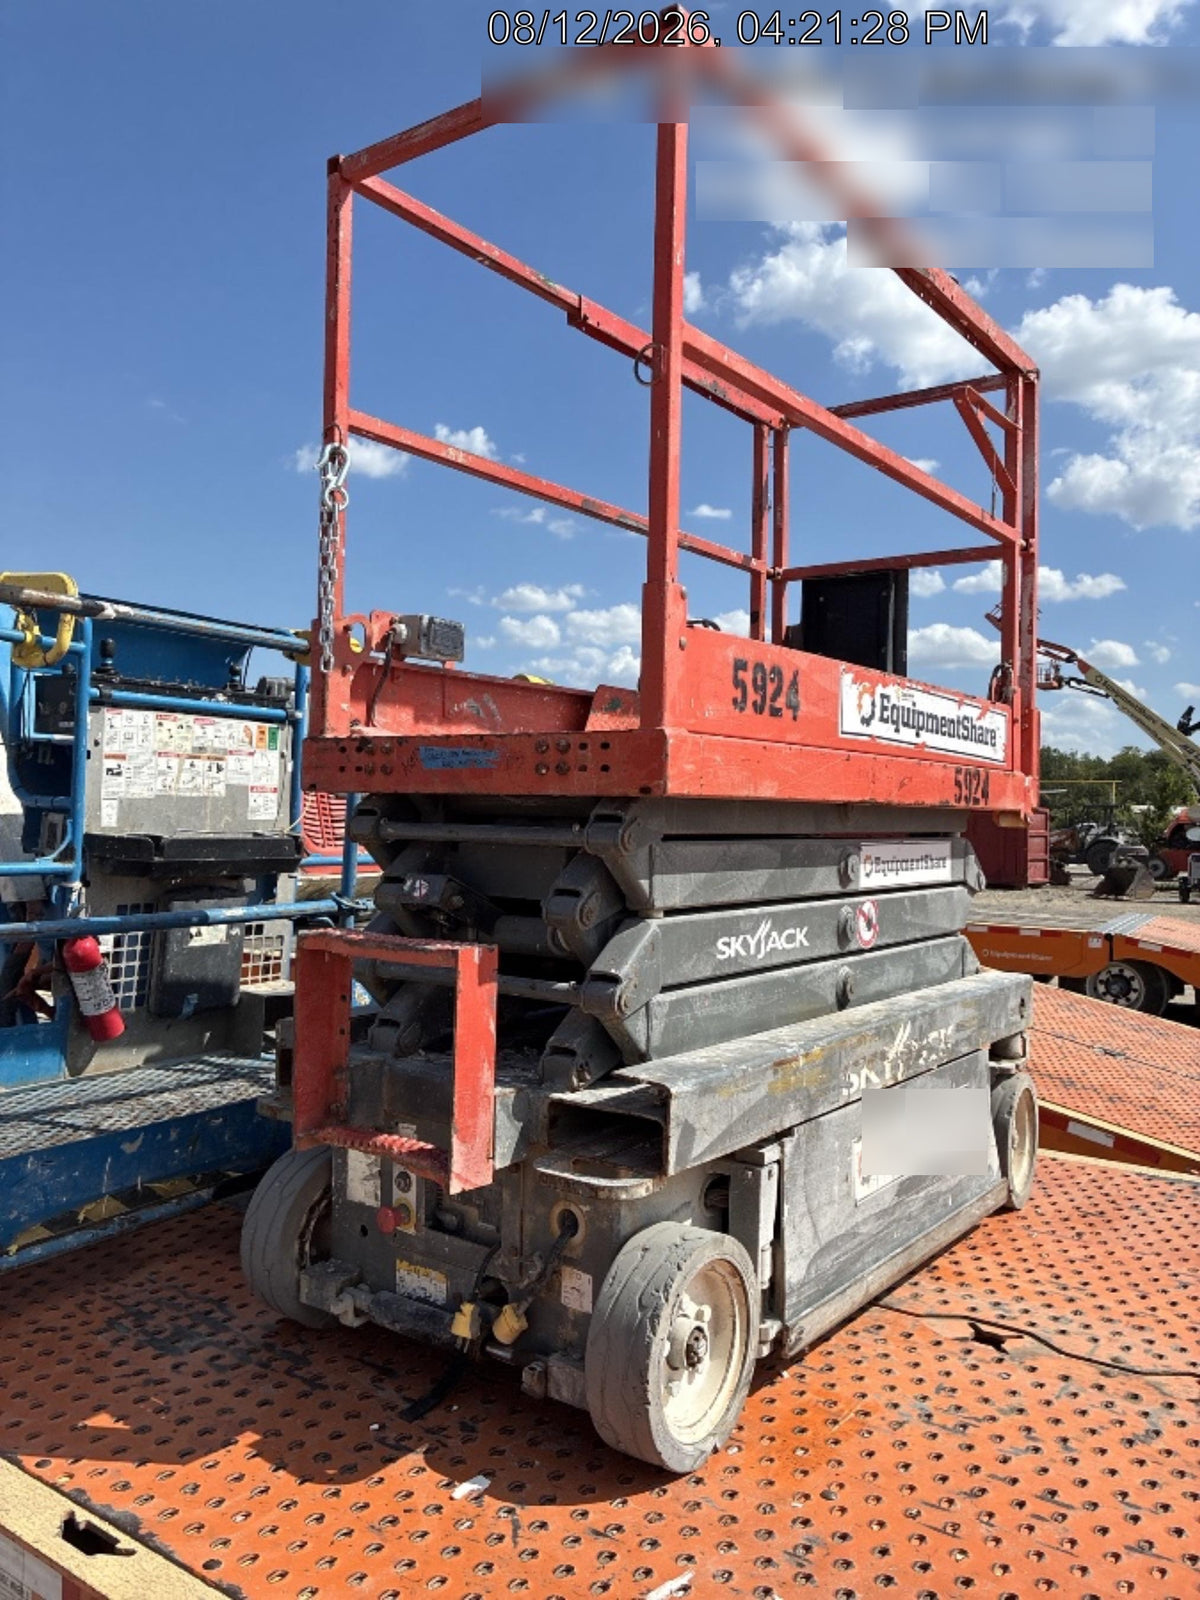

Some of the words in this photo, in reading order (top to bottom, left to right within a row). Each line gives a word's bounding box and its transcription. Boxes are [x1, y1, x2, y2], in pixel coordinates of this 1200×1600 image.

[732, 658, 799, 721] 5924
[879, 693, 997, 747] EquipmentShare
[954, 768, 990, 805] 5924
[874, 854, 947, 877] EquipmentShare
[716, 917, 810, 960] SKYJACK
